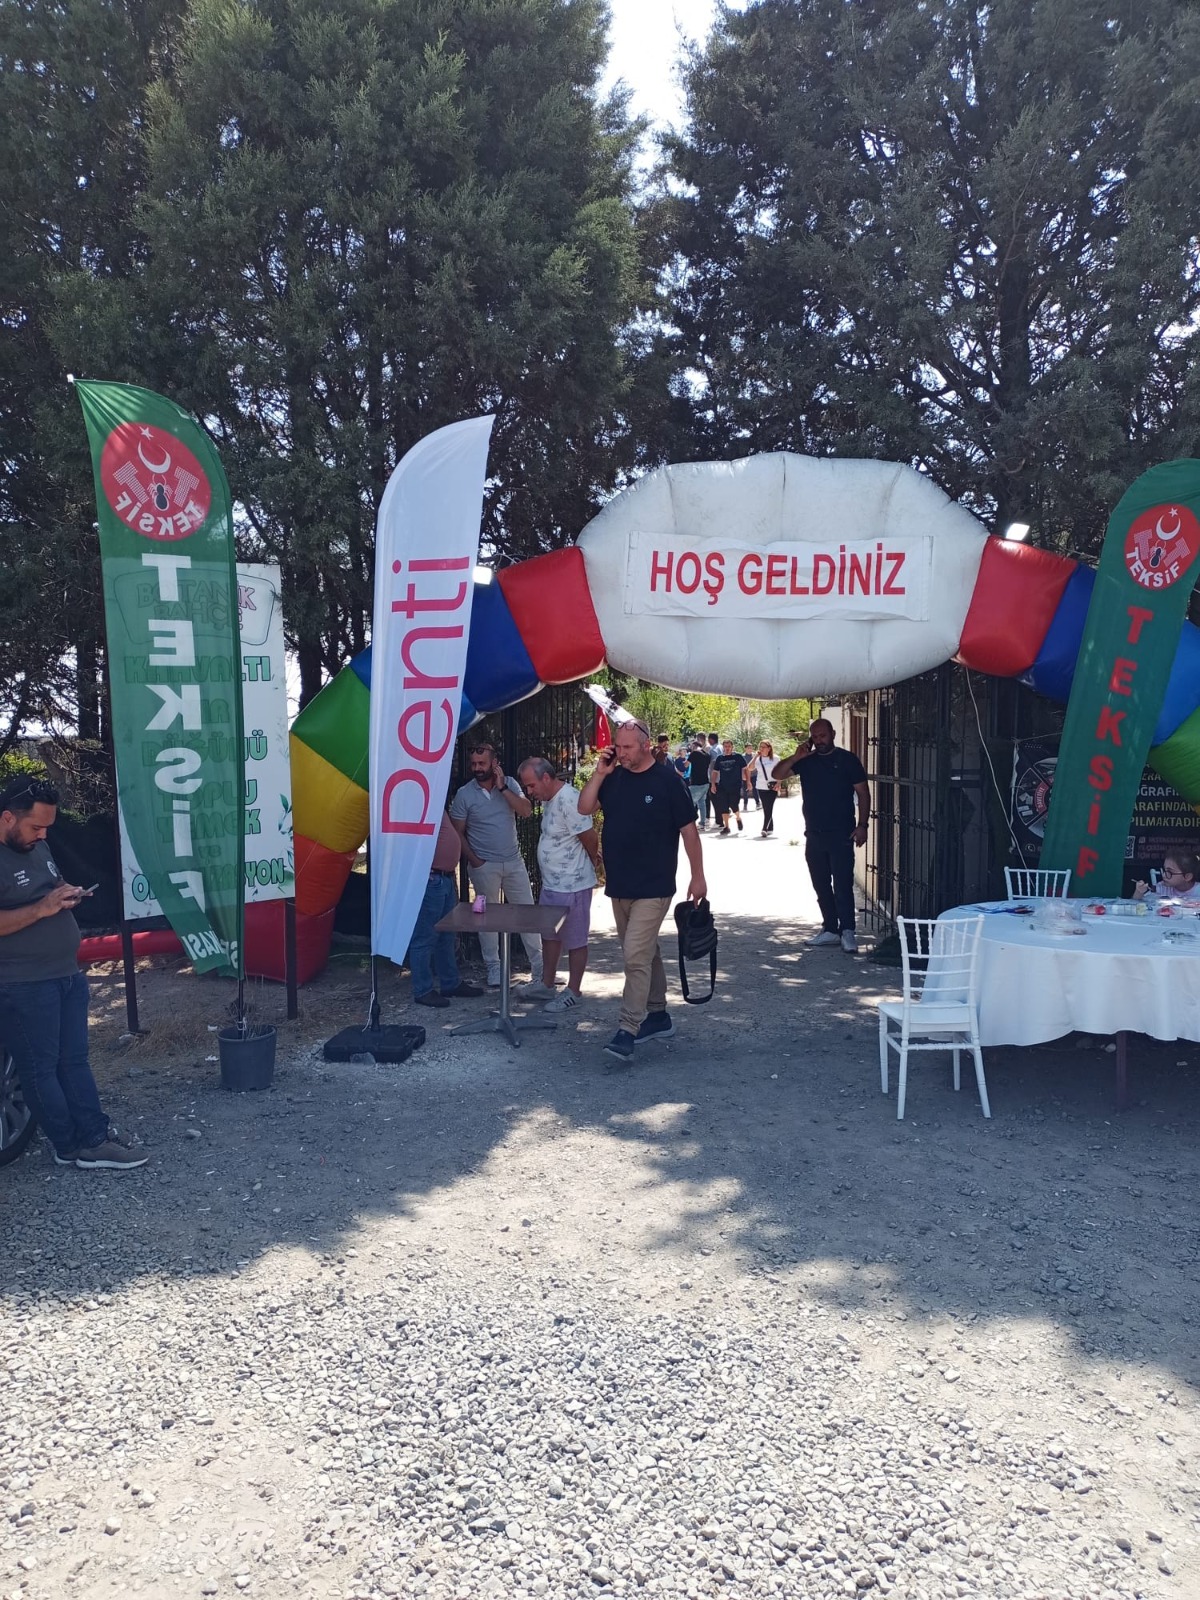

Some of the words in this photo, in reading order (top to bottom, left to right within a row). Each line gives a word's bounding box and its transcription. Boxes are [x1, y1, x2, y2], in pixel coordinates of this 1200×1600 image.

[650, 550, 726, 605] HOŞ
[737, 543, 906, 595] GELDİNİZ
[1126, 547, 1180, 587] TEKSİF
[1076, 606, 1154, 879] TEKSİF
